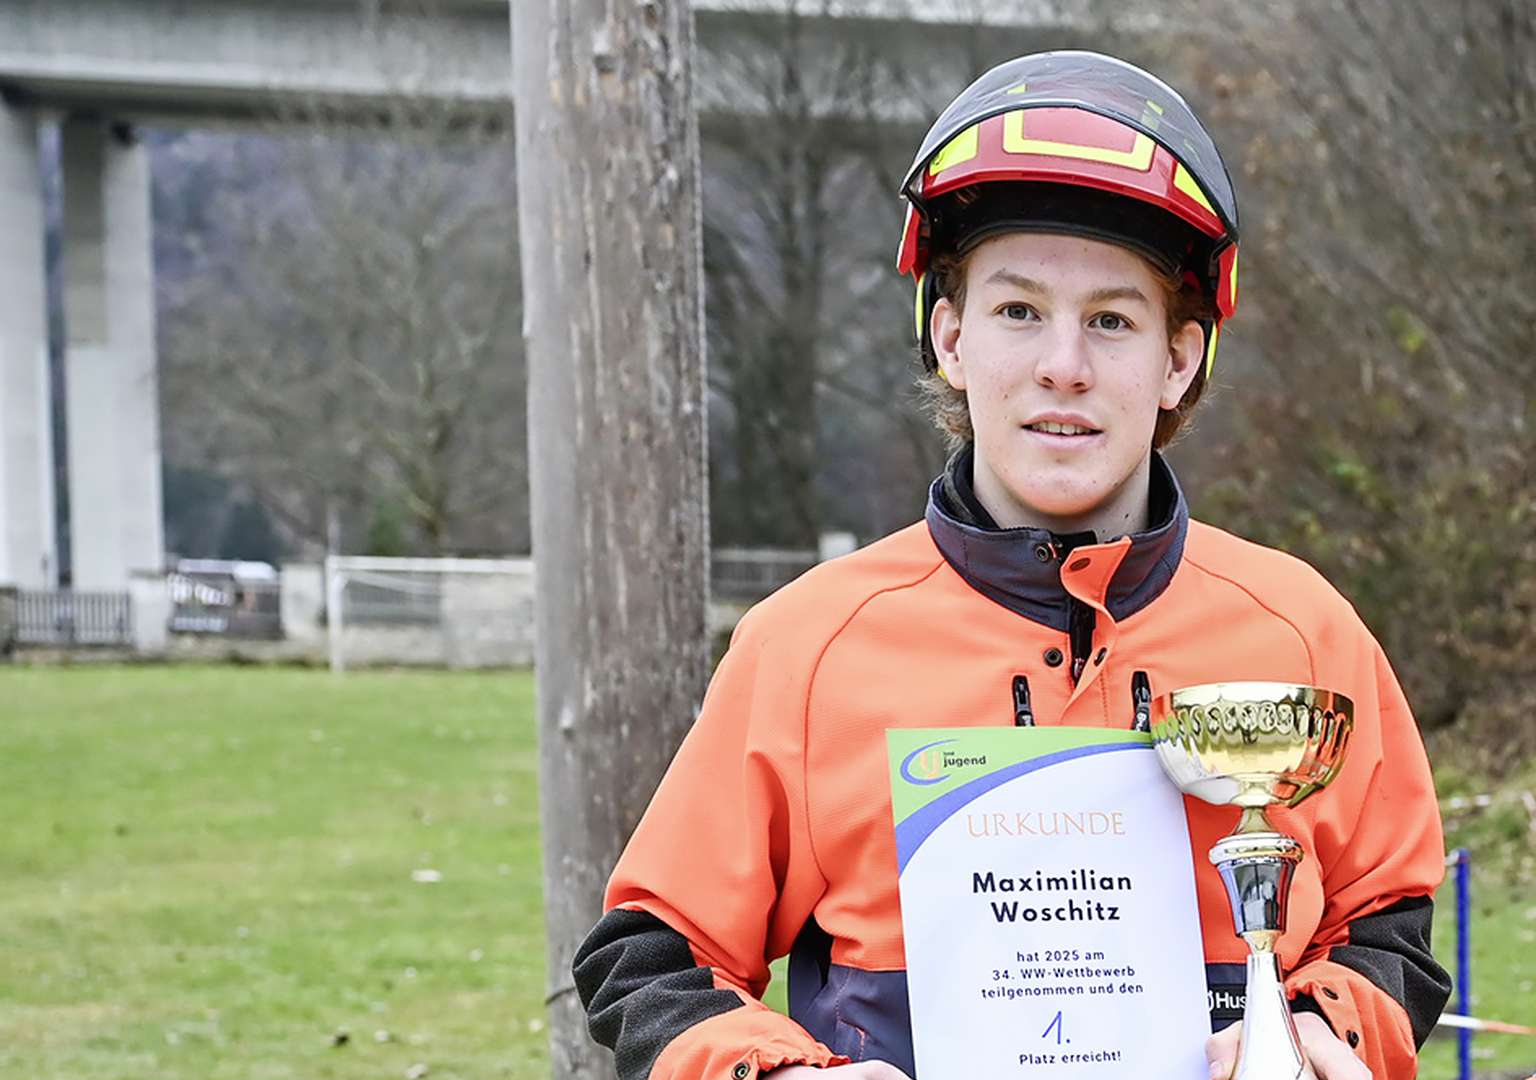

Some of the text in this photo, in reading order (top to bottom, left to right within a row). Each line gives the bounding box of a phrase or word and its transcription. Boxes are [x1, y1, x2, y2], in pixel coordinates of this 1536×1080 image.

[943, 755, 987, 768] jugend
[967, 811, 1126, 838] URKUNDE
[972, 868, 1132, 893] Maximilian
[990, 898, 1121, 923] Woschitz
[1016, 950, 1105, 962] hat 2025 am
[992, 965, 1135, 981] 34. WW-Wettbewerb
[981, 983, 1144, 1000] teilgenommen und den
[1041, 1010, 1071, 1045] 1.
[1019, 1050, 1121, 1065] Platz erreicht!
